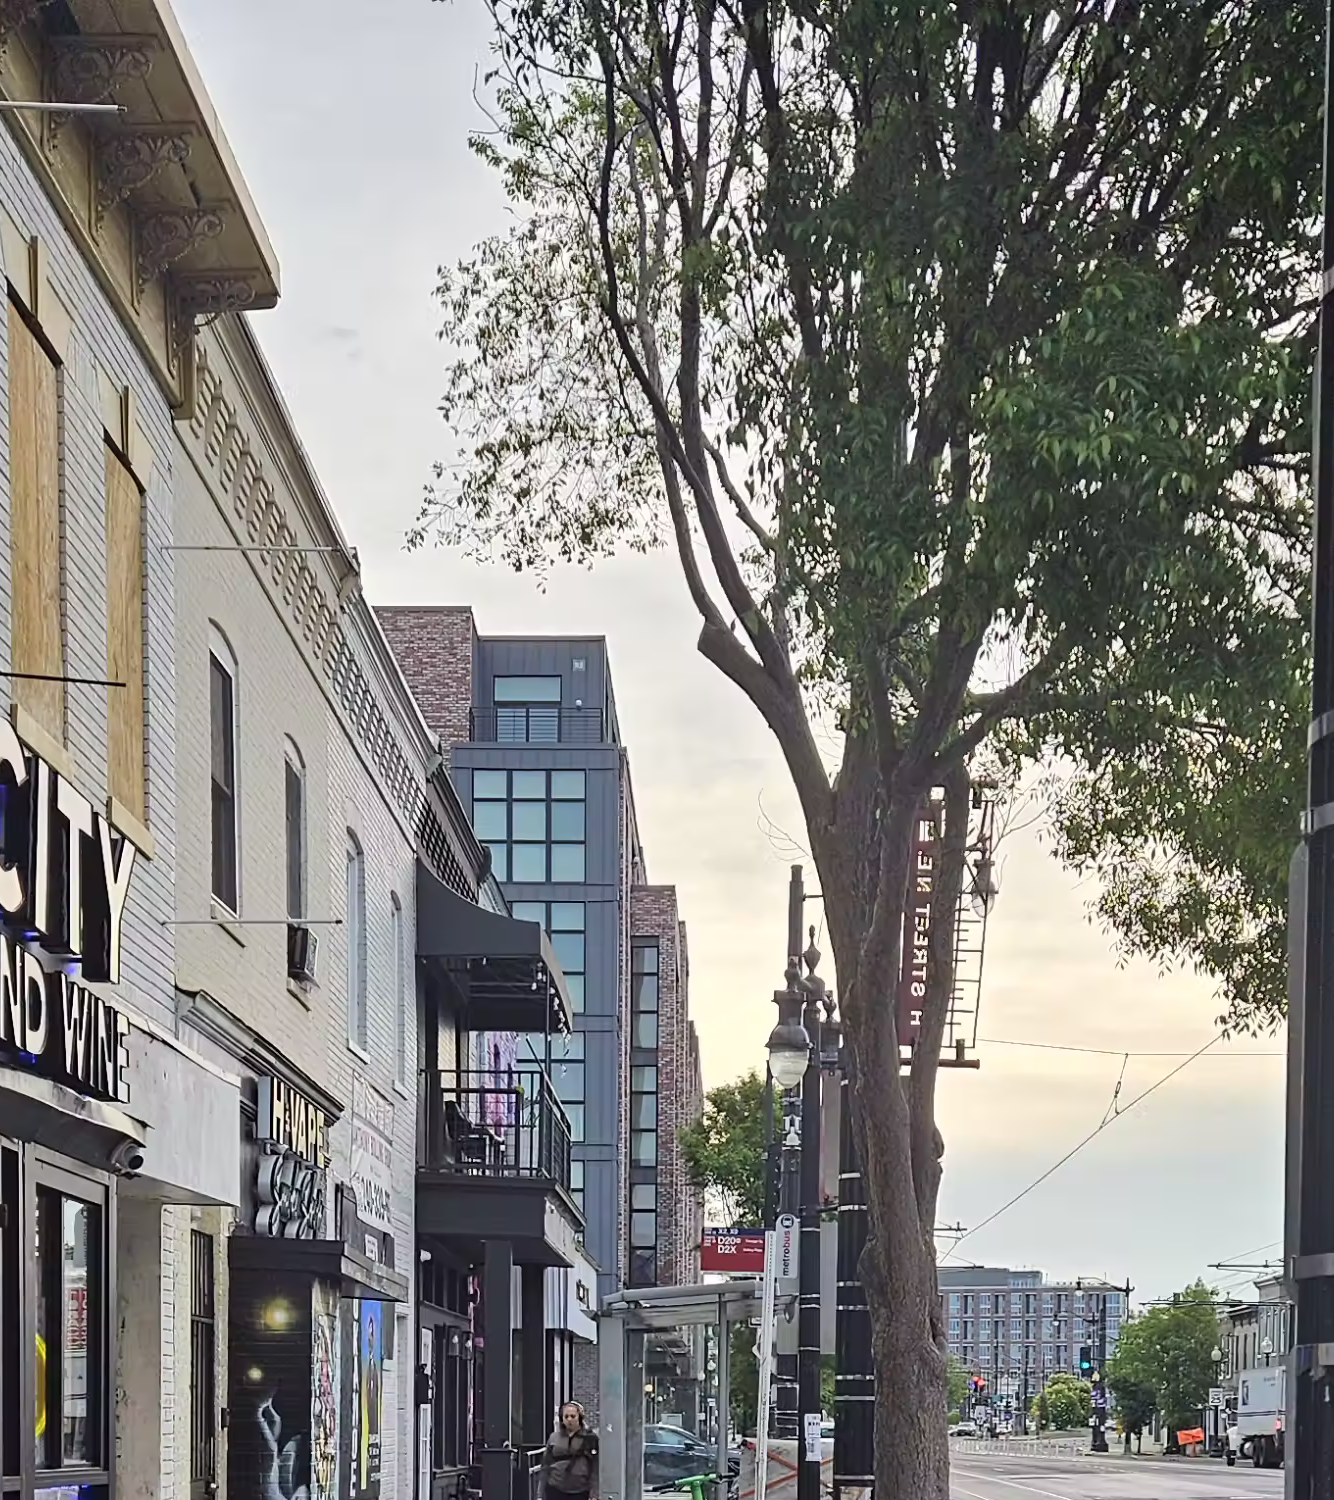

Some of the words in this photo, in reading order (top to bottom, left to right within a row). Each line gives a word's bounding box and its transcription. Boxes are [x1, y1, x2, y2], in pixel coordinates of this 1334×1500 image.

[63, 973, 131, 1104] WINE
[718, 1237, 735, 1245] D20
[718, 1245, 737, 1253] D2X
